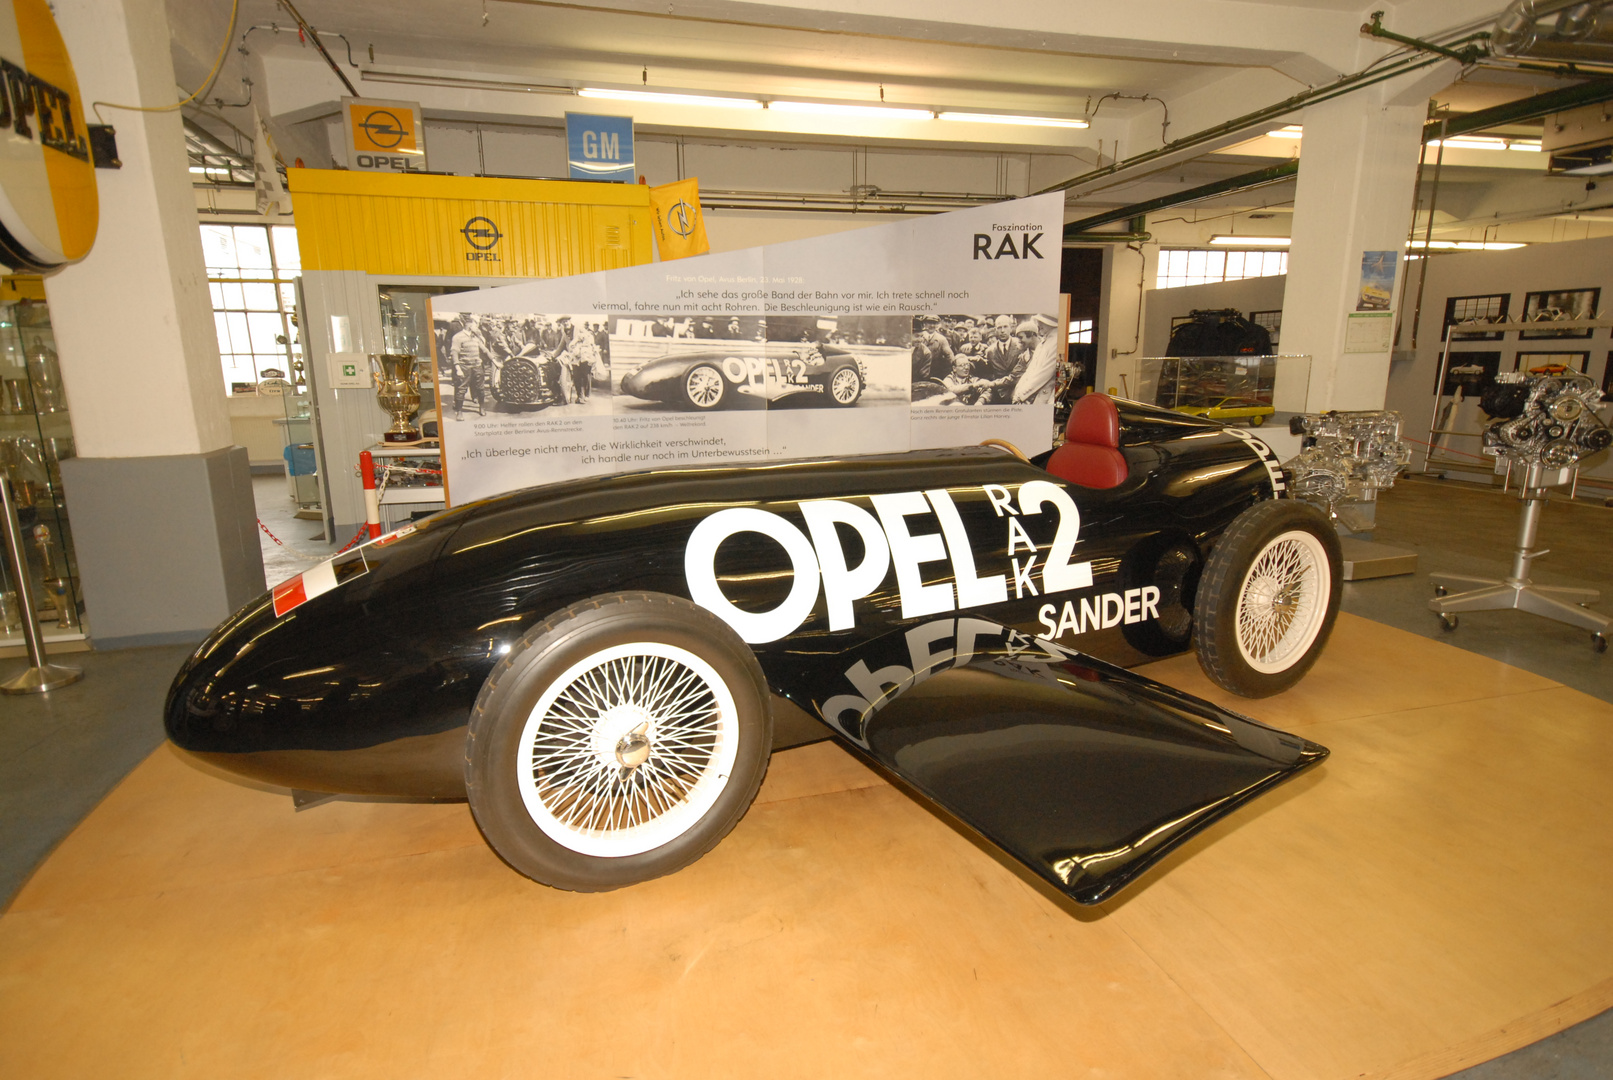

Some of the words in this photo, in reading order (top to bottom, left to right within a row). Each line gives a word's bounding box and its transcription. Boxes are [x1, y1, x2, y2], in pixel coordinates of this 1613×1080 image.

[582, 130, 620, 160] GM
[356, 154, 419, 170] OPEL
[992, 223, 1043, 232] Faszination
[973, 232, 1045, 260] RAK
[466, 252, 501, 262] OPEL
[698, 275, 716, 284] Opel,
[760, 276, 771, 284] 23.
[697, 290, 719, 299] sehe
[721, 290, 739, 299] das
[741, 289, 769, 302] große
[771, 290, 795, 300] Band
[797, 290, 812, 299] der
[815, 290, 839, 299] Bahn
[857, 291, 873, 299] mir.
[876, 290, 890, 299] Ich
[892, 291, 913, 299] trete
[915, 290, 945, 299] schnell
[948, 290, 970, 299] noch
[592, 302, 632, 311] viermal,
[634, 302, 660, 311] fahre
[684, 302, 698, 311] mit
[701, 303, 722, 311] acht
[725, 303, 760, 311] Rohren.
[764, 303, 778, 311] Die
[780, 303, 850, 314] Beschleunigung
[853, 303, 863, 311] ist
[865, 303, 880, 311] wie
[883, 303, 896, 311] ein
[722, 357, 788, 386] OPEL
[784, 359, 795, 384] RAK
[792, 359, 808, 383] 2
[485, 447, 531, 458] überlege
[534, 445, 558, 455] nicht
[561, 444, 589, 454] mehr,
[592, 442, 606, 451] die
[609, 440, 662, 450] Wirklichkeit
[665, 437, 726, 448] verschwindet,
[581, 455, 595, 464] ich
[598, 453, 631, 463] handle
[652, 452, 674, 460] noch
[677, 450, 689, 458] im
[691, 447, 770, 458] Unterbewusstsein
[684, 488, 1008, 644] OPEL
[982, 483, 1039, 599] RAK
[1018, 480, 1093, 594] 2
[1037, 586, 1161, 642] SANDER
